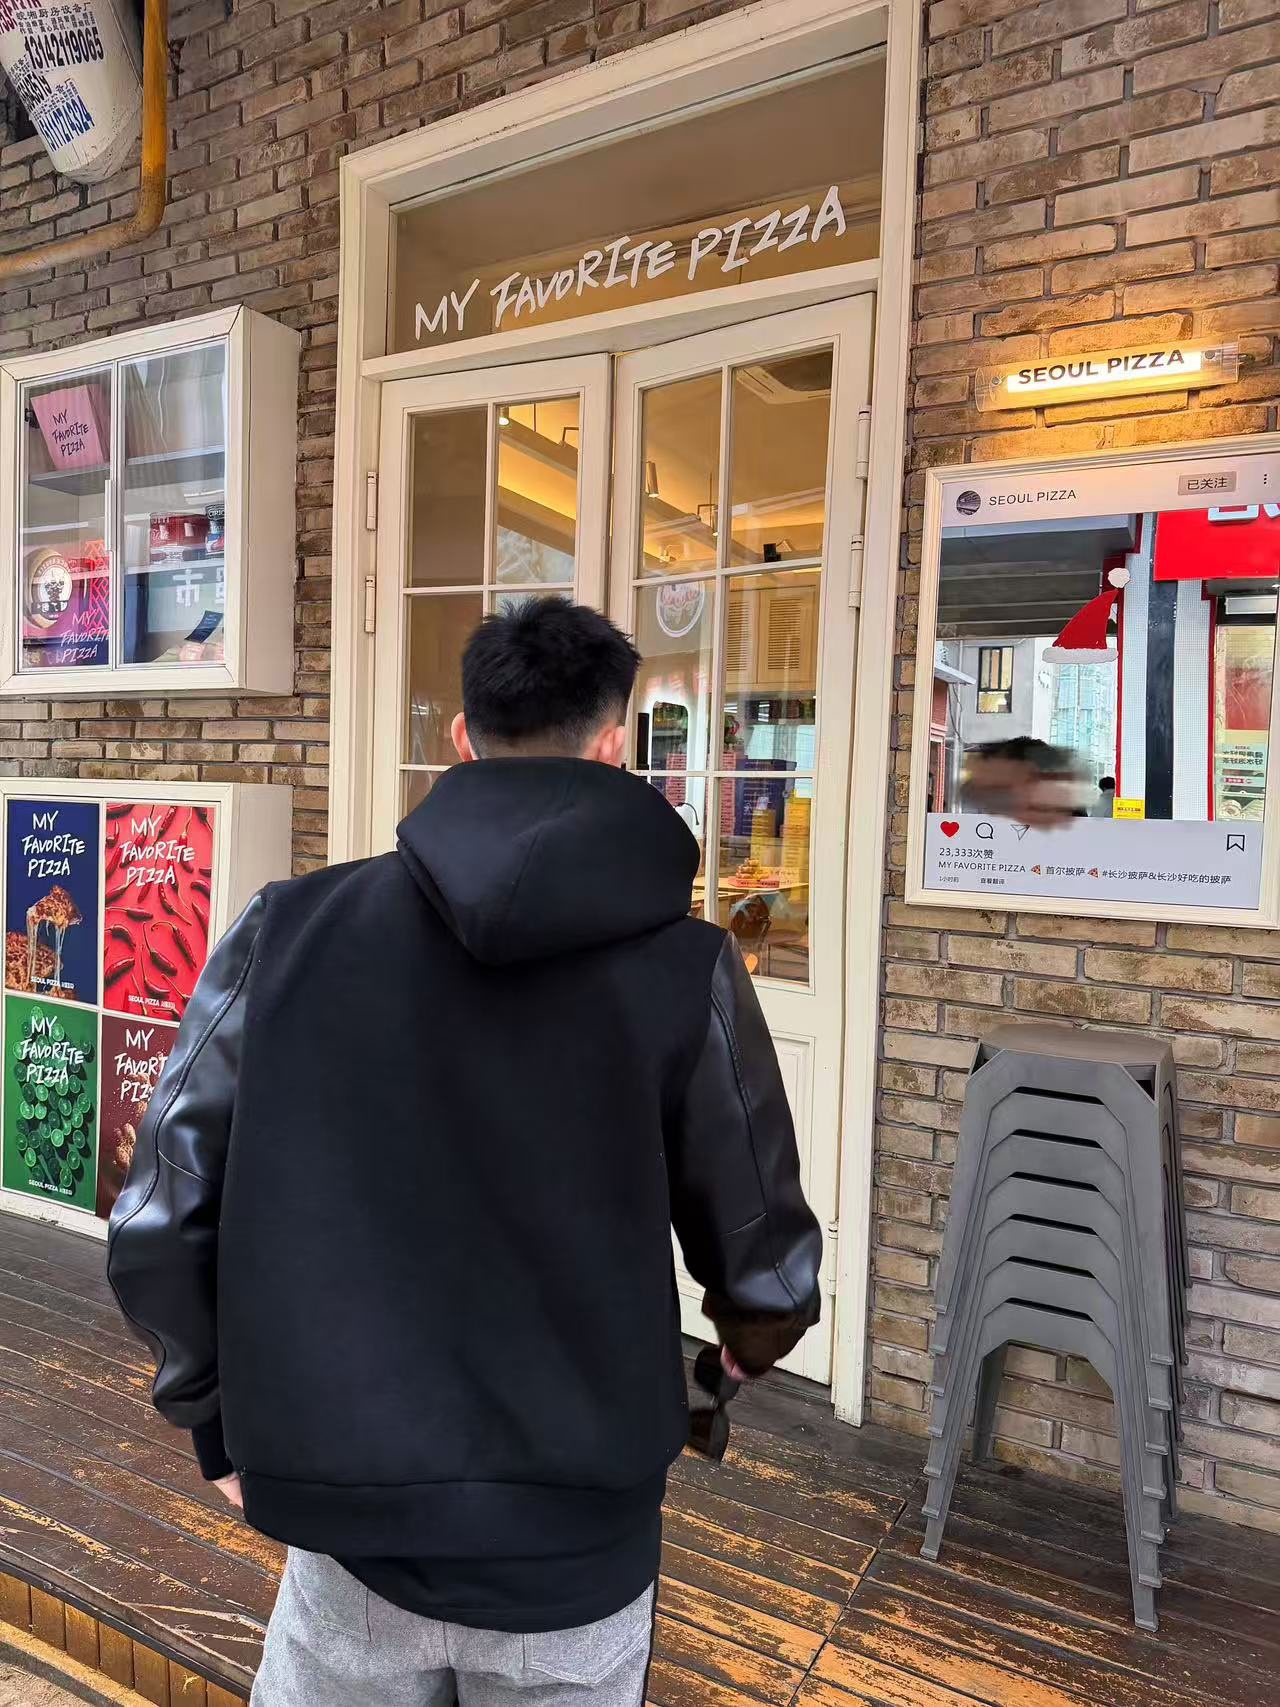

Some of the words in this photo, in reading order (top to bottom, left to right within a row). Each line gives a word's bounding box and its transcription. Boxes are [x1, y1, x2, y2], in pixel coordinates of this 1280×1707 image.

[24, 26, 104, 70] 13142119065
[414, 278, 481, 341] MY
[489, 235, 676, 328] FAVORITE
[688, 185, 848, 281] PIZZA
[1018, 360, 1099, 385] SEOUL
[1107, 348, 1185, 373] PIZZA
[52, 408, 69, 426] MY
[51, 420, 90, 443] FAVORITE
[60, 438, 86, 457] PIZZA
[1187, 476, 1228, 491] 已关注
[989, 492, 1034, 507] SEOUL
[1036, 489, 1077, 503] PIZZA
[72, 608, 97, 626] MY
[61, 644, 98, 664] PIZZA
[32, 810, 59, 831] MY
[130, 815, 163, 837] MY
[22, 833, 86, 856] FAVORITE
[119, 839, 196, 864] FAVORITE
[939, 847, 994, 860] 23,333次赞
[27, 857, 71, 878] PIZZA
[126, 865, 176, 887] PIZZA
[938, 861, 952, 869] MY
[953, 862, 996, 872] FAVORITE
[998, 864, 1027, 873] PIZZA
[1045, 866, 1086, 877] 首尔披萨
[1102, 869, 1232, 885] #长沙披萨&长沙好吃的披萨
[30, 976, 46, 986] SEOUL
[128, 995, 144, 1004] SEOUL
[145, 997, 160, 1006] PIZZA
[31, 1015, 58, 1038] MY
[125, 1028, 155, 1051] MY
[20, 1038, 85, 1065] FAVORITE
[26, 1063, 70, 1085] PIZZA
[121, 1080, 155, 1102] PIZ
[28, 1179, 45, 1189] SEOUL
[44, 1182, 59, 1192] PIZZA
